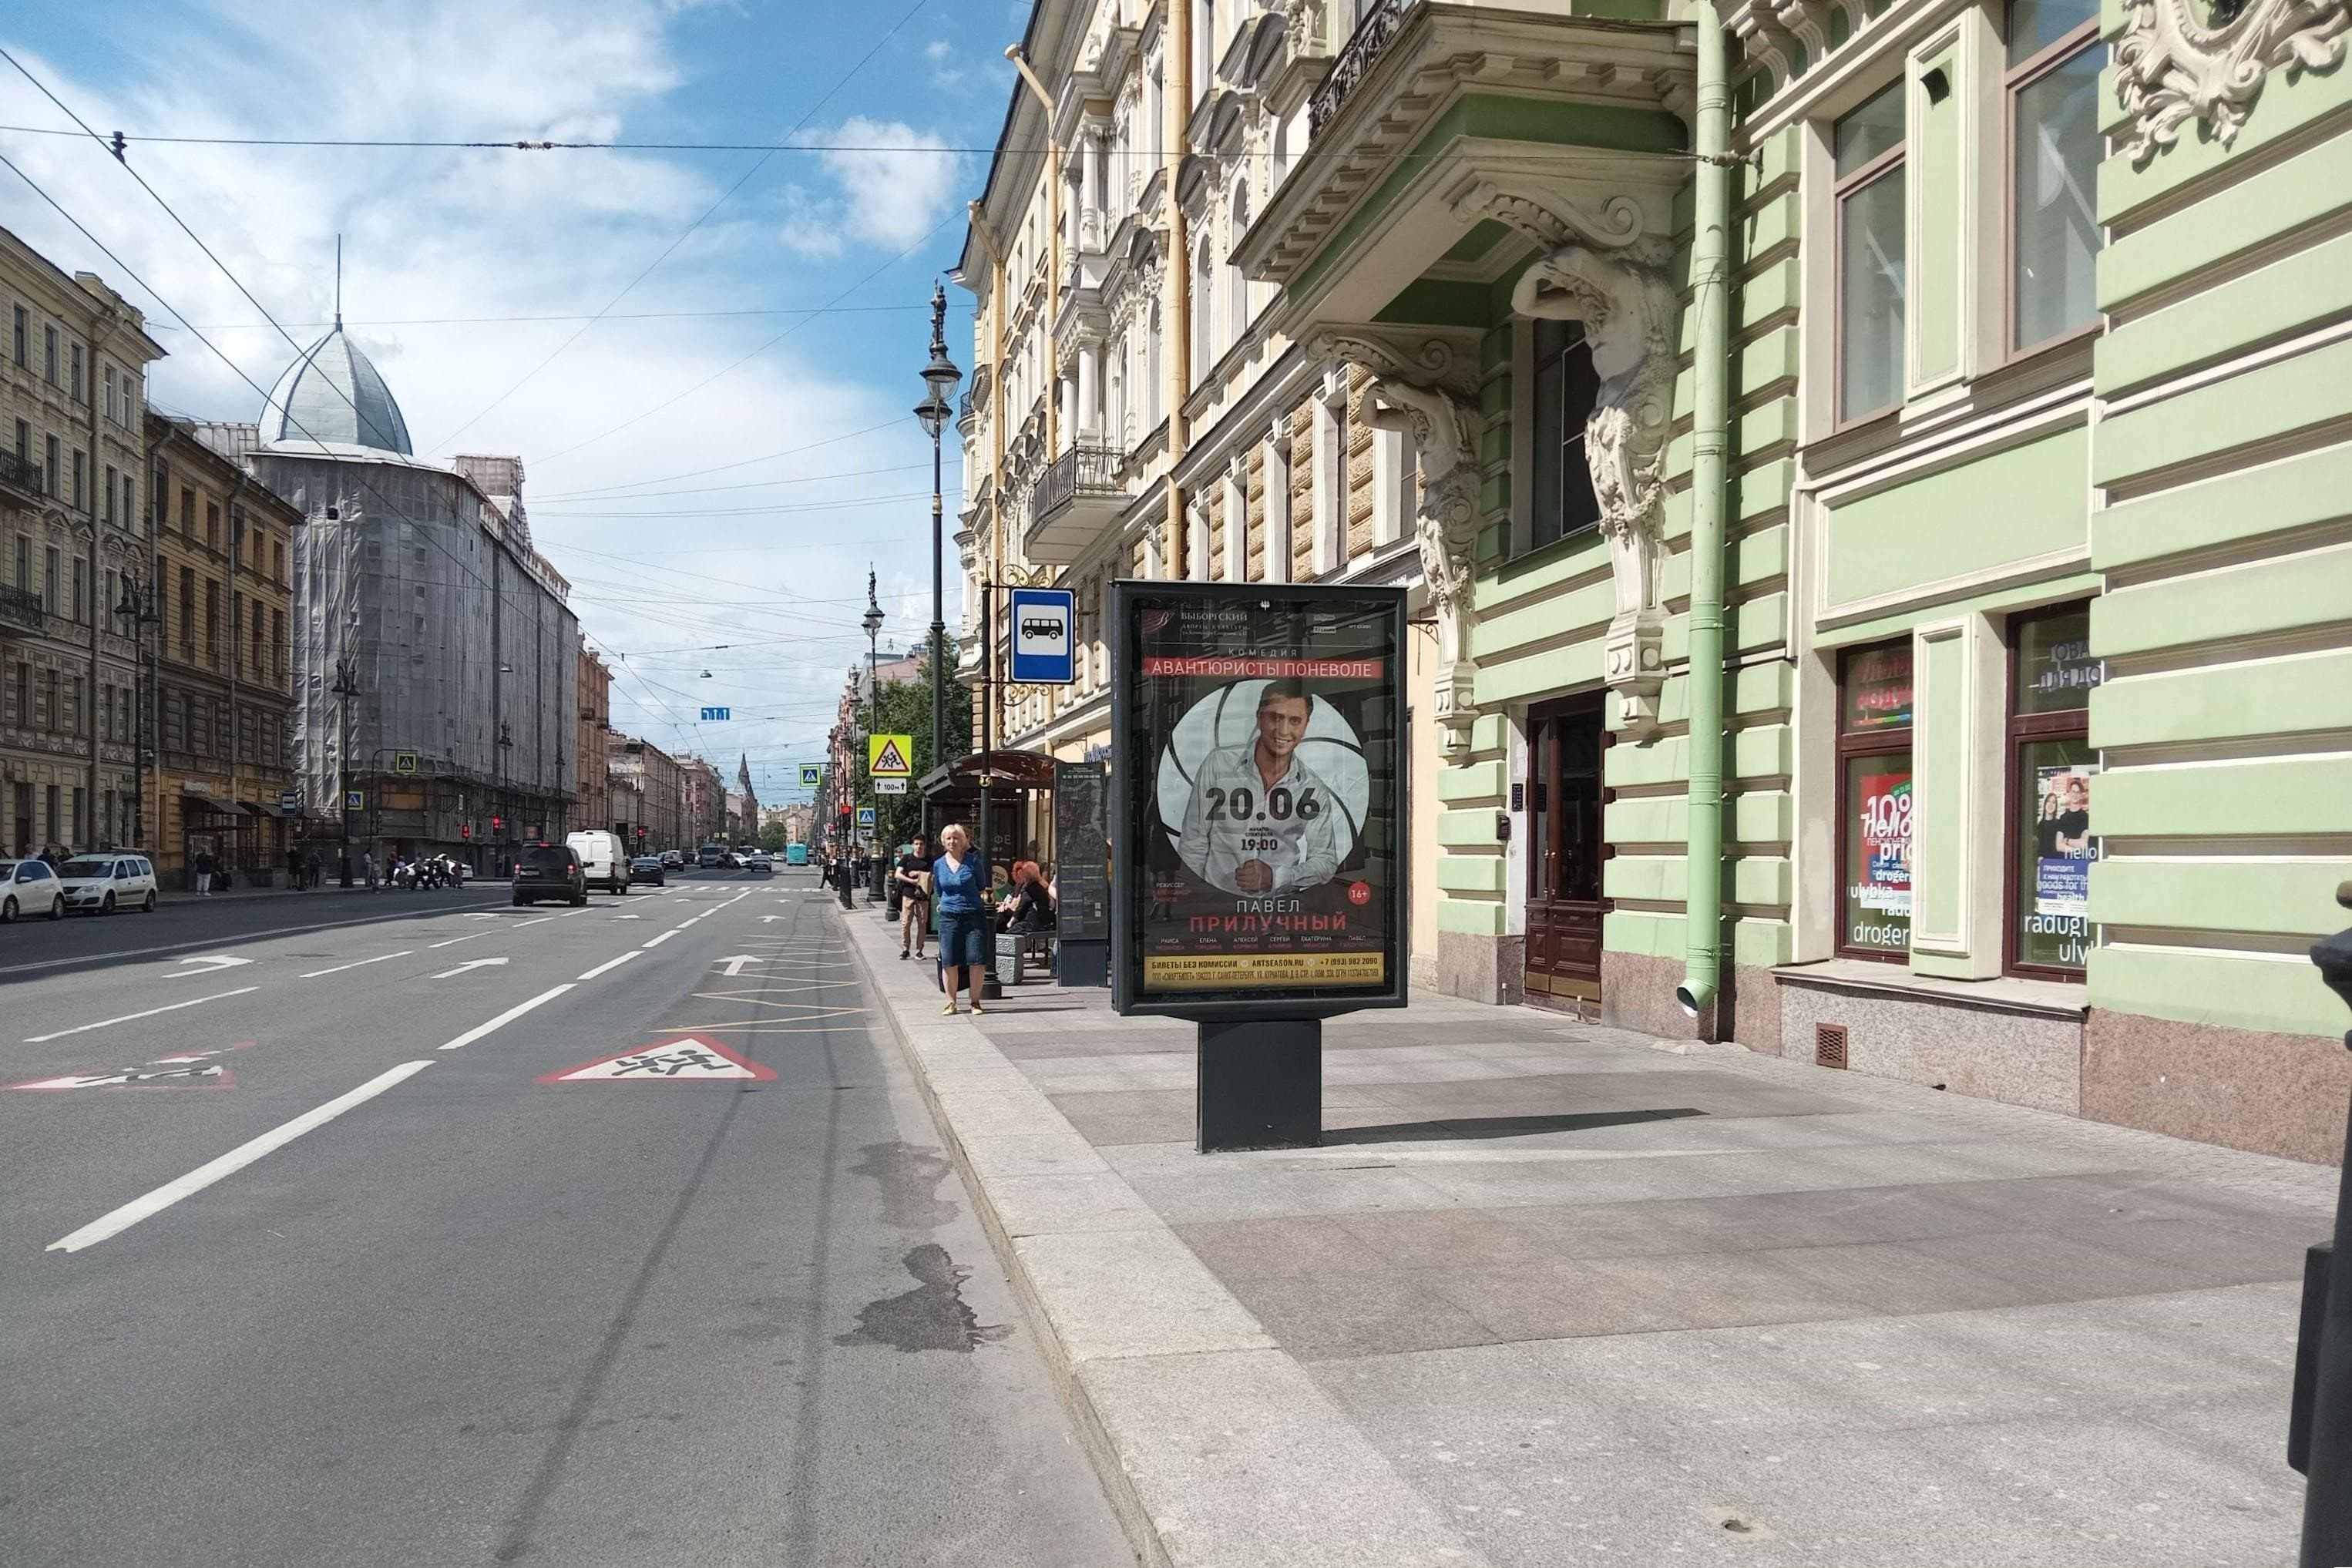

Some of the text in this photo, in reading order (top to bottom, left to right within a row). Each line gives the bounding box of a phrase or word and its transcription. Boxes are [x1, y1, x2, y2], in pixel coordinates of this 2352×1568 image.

[1181, 612, 1248, 621] ВЫБОРГСКИЙ
[1228, 648, 1297, 657] КОМЕДИЯ
[1152, 660, 1372, 677] АВАНТЮРИСТЫ ПОНЕВОЛЕ
[1205, 787, 1320, 821] 20.06
[1241, 838, 1278, 851] 19:00
[2036, 878, 2062, 891] goods
[2065, 880, 2078, 891] for
[1351, 889, 1368, 898] 16+
[1236, 900, 1299, 913] ПАВЕЛ
[1189, 911, 1347, 932] ПРИЛУЧНЫЙ
[1198, 960, 1238, 969] КОМИССИИ
[1252, 959, 1304, 967] ARTSEASON.RU
